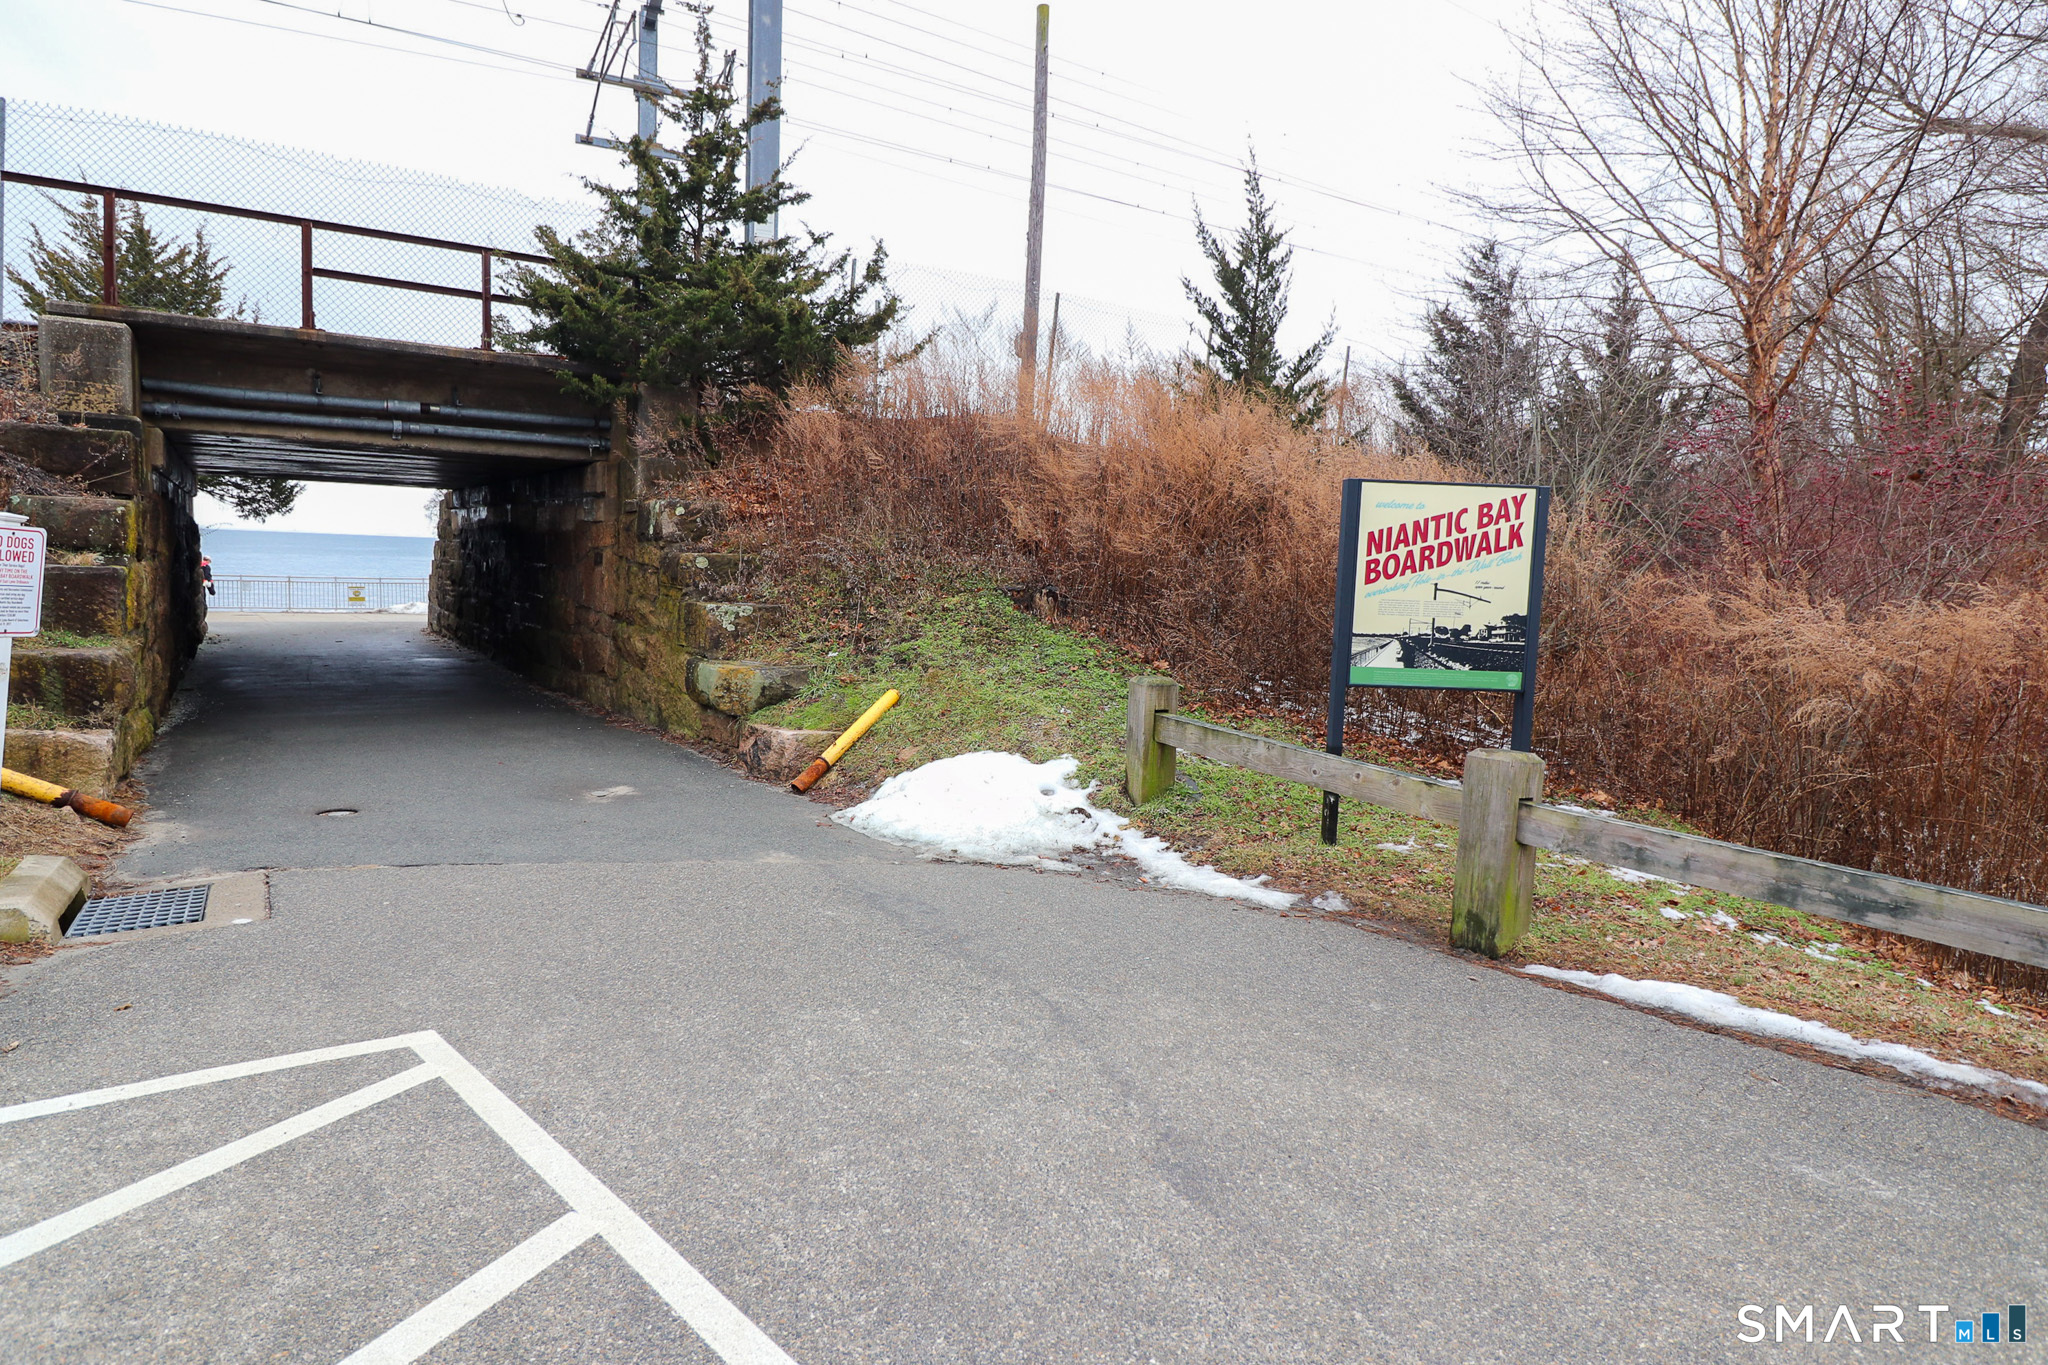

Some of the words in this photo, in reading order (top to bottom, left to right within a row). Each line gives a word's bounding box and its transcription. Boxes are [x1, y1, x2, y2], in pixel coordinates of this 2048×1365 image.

[1375, 499, 1414, 510] welcome
[1415, 501, 1426, 510] to
[1366, 507, 1469, 558] NIANTIC
[1477, 493, 1527, 530] BAY
[6, 535, 35, 550] DOGS
[1364, 522, 1525, 586] BOARDWALK
[1496, 551, 1524, 567] Beach
